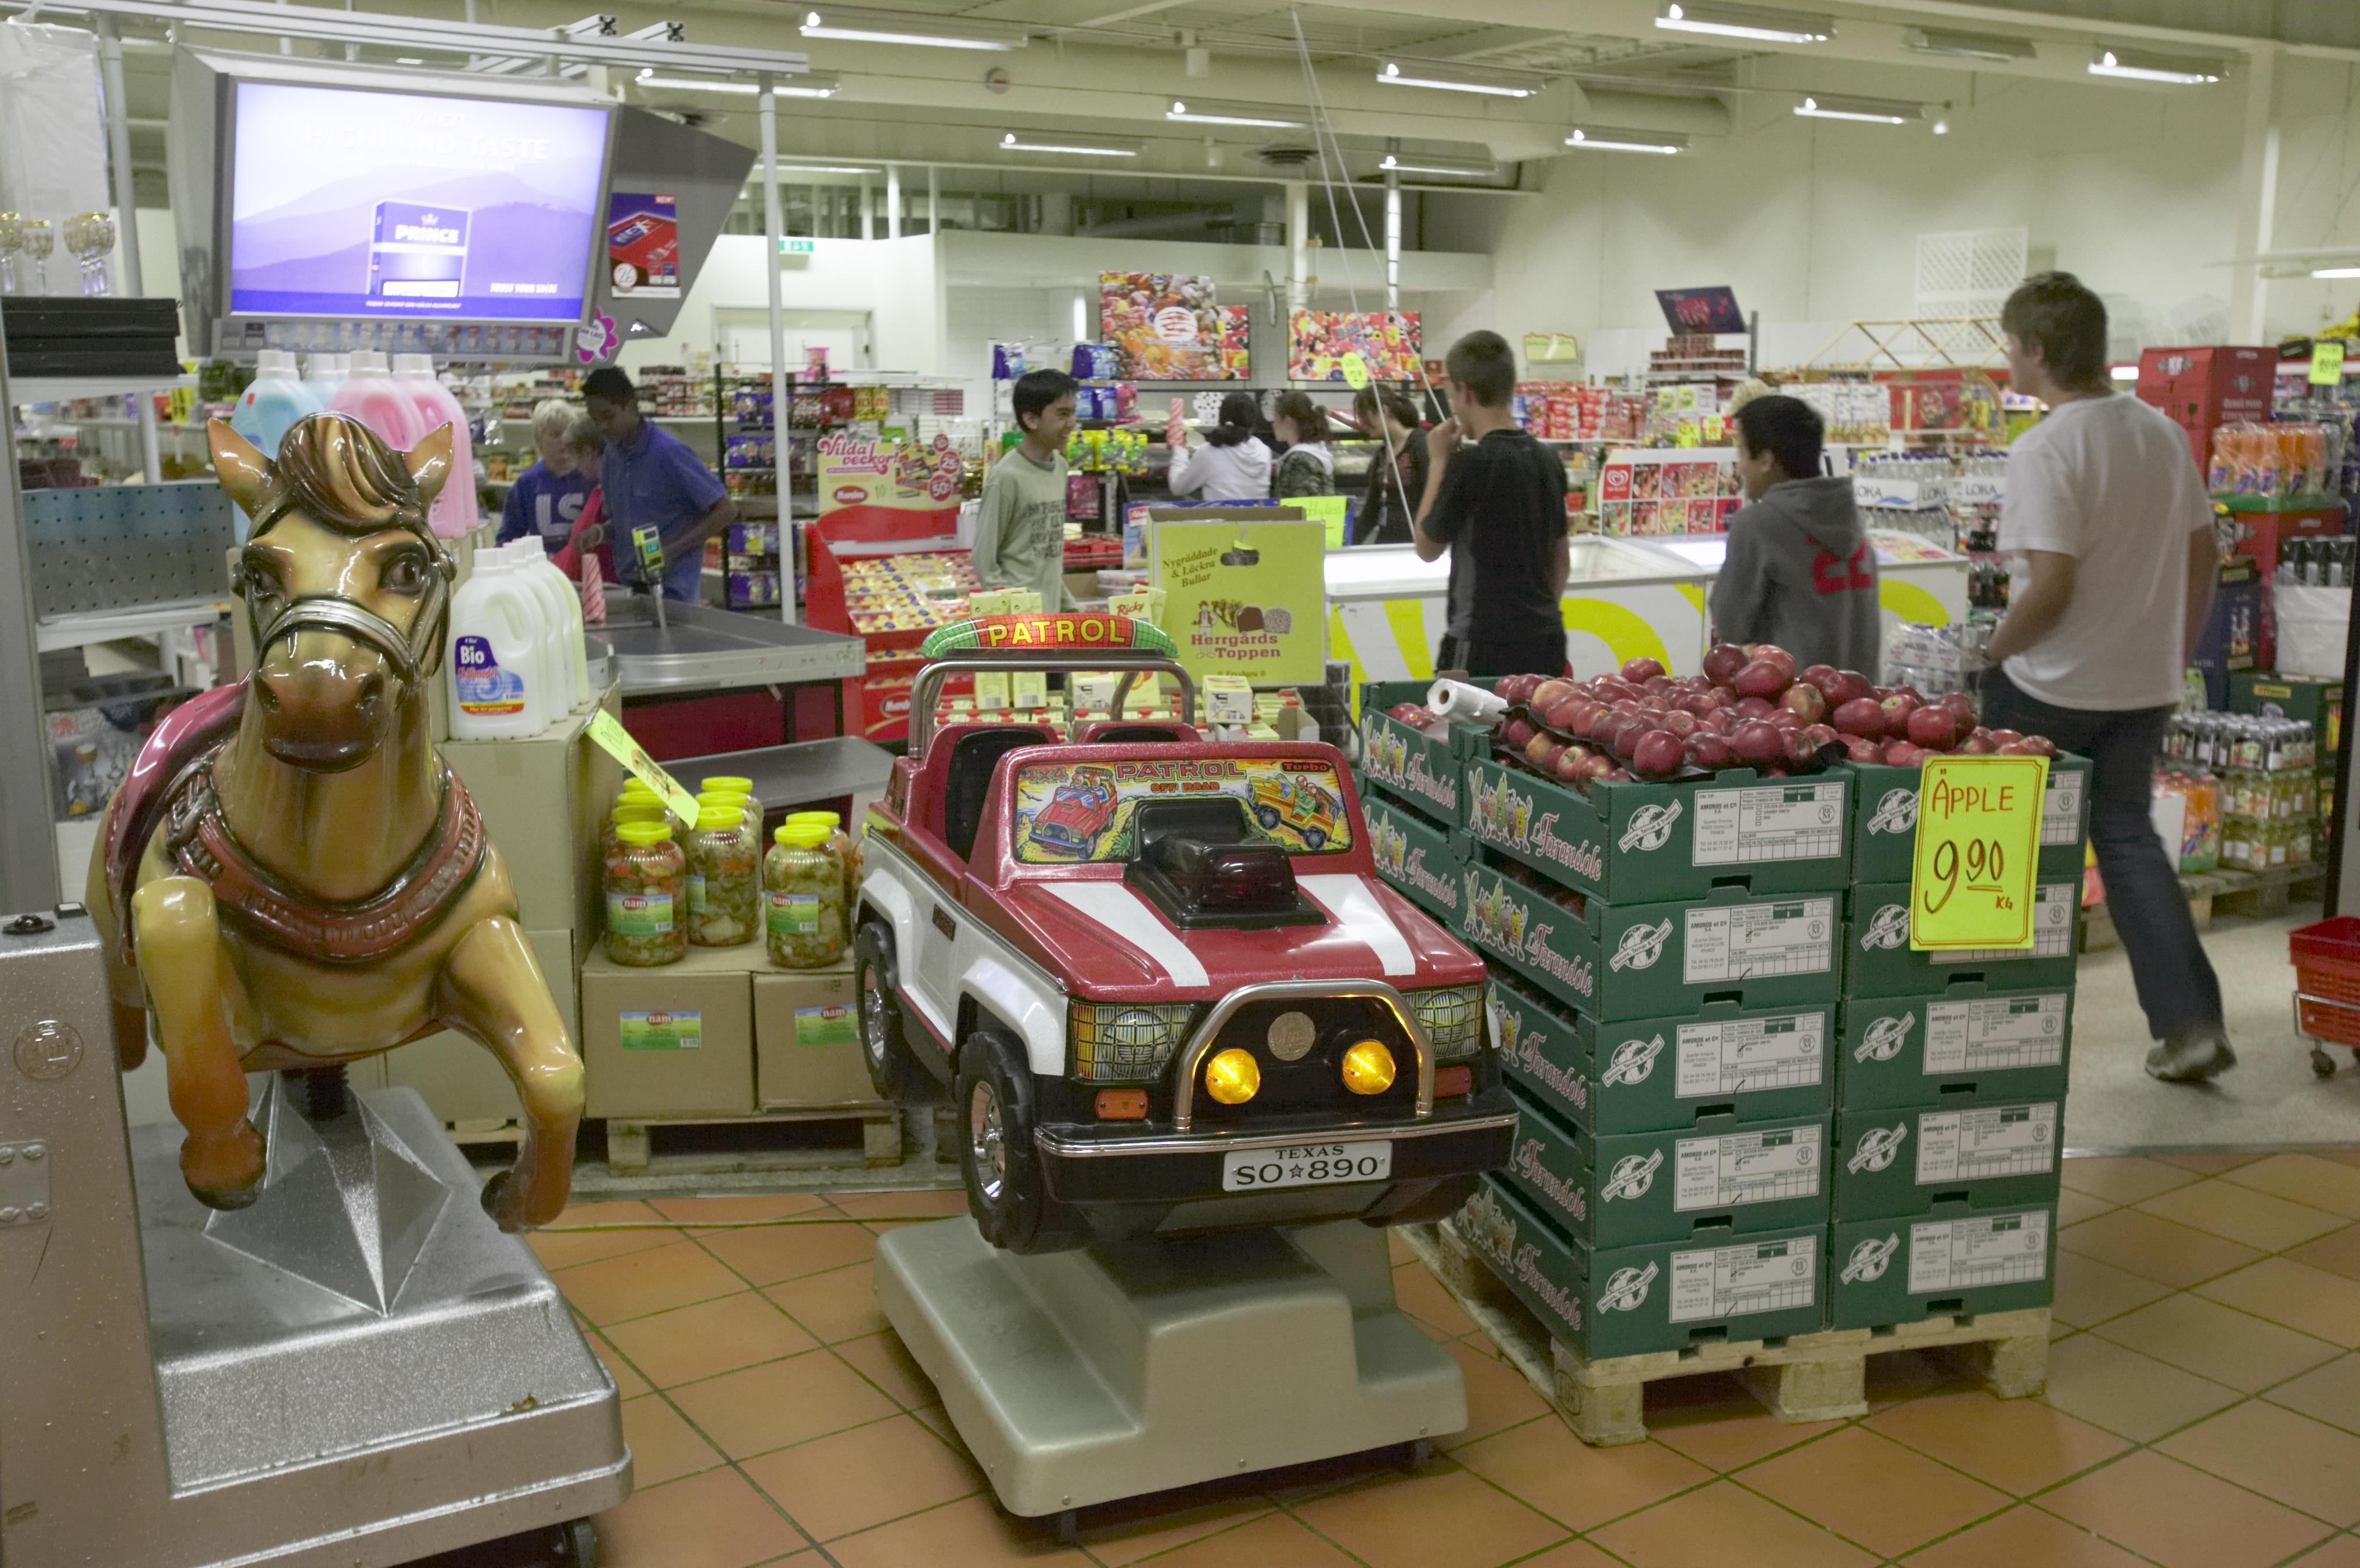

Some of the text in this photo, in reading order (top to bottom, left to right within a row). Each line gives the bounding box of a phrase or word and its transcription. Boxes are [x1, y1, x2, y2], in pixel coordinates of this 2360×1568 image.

[465, 134, 551, 160] TASTE
[395, 224, 459, 243] PRINCE
[818, 434, 866, 456] Vilda
[1966, 484, 1998, 495] LOKA
[1162, 547, 1218, 570] Nygräddade
[1182, 560, 1216, 576] Läckra
[1182, 573, 1212, 588] Bullar
[988, 619, 1125, 646] PATROL
[1191, 633, 1278, 649] Herrgårds
[460, 645, 485, 664] Bio
[1215, 646, 1281, 660] Toppen
[1022, 761, 1330, 784] 4x4 PATROL Turbo
[1150, 781, 1221, 793] OFF ROAD
[1932, 768, 2013, 819] ÄPPLE
[1535, 812, 1602, 882] Farandole
[1529, 923, 1593, 997] Farandole
[648, 1015, 672, 1023] nam
[1275, 1145, 1344, 1160] TEXAS
[1236, 1157, 1378, 1185] SO 890
